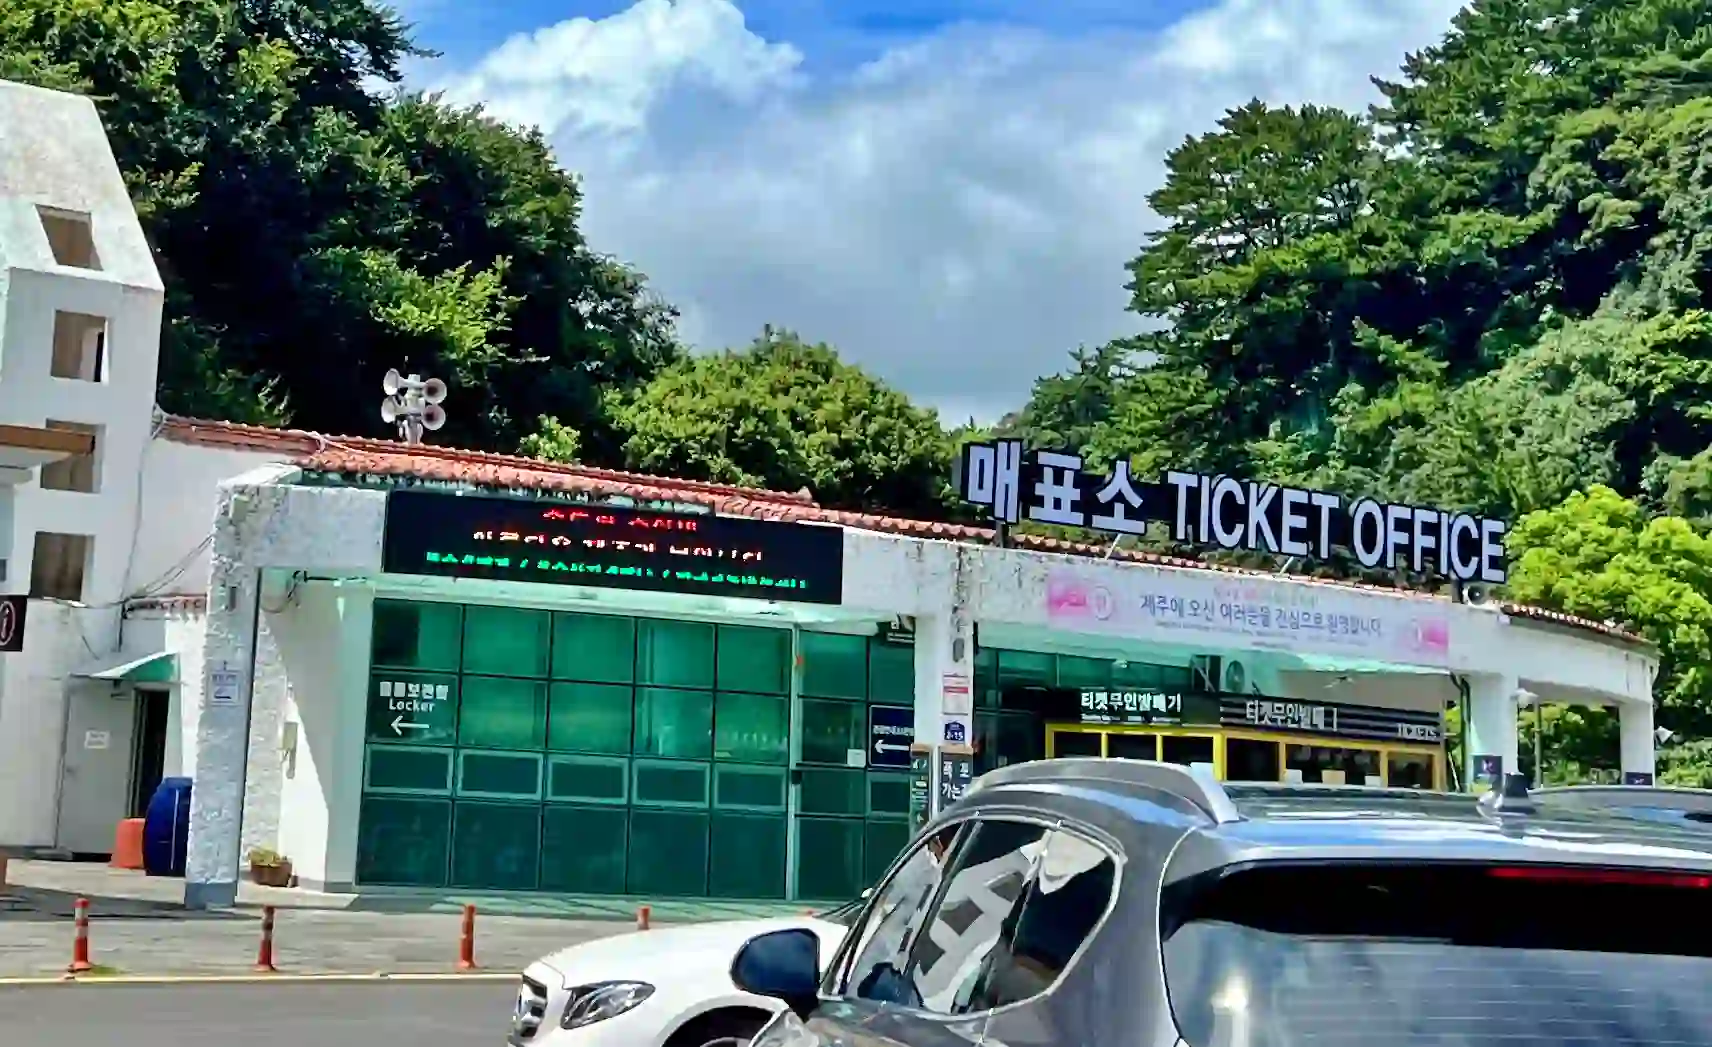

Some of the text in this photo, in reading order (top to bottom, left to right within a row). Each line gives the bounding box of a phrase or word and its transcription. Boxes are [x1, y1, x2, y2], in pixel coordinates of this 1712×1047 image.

[968, 441, 1505, 583] 매표소 TICKET OFFICE
[1140, 594, 1184, 618] 제주에
[1187, 599, 1215, 622] 오신
[388, 698, 436, 712] Locker
[1081, 692, 1181, 713] 티켓무인발매기
